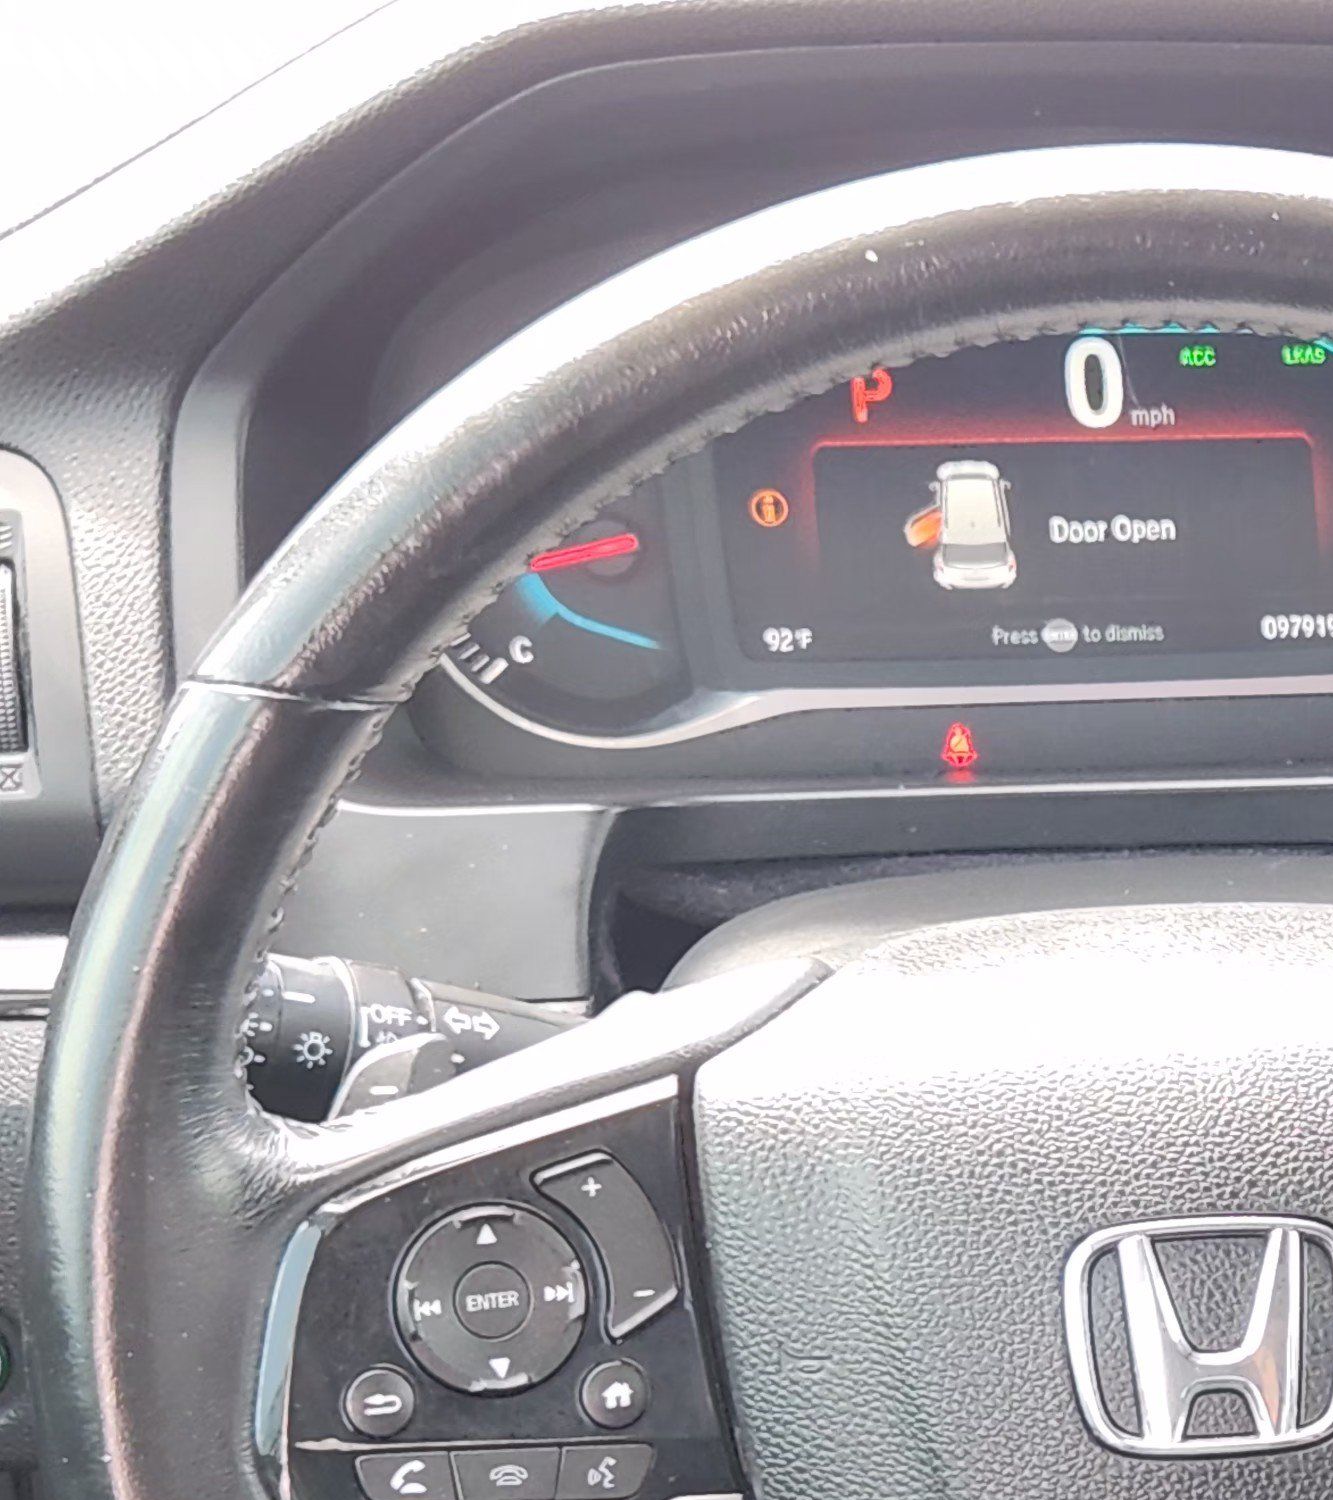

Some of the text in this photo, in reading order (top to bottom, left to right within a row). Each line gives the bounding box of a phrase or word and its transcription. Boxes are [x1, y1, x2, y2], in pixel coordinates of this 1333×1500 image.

[850, 367, 892, 422] P
[1065, 336, 1123, 429] 0
[1130, 403, 1175, 429] mph
[1049, 514, 1177, 547] Door Open
[1082, 625, 1102, 643] to
[1105, 624, 1164, 642] dismiss
[508, 636, 534, 664] C
[370, 1003, 413, 1027] OFF
[466, 1289, 520, 1312] ENTER
